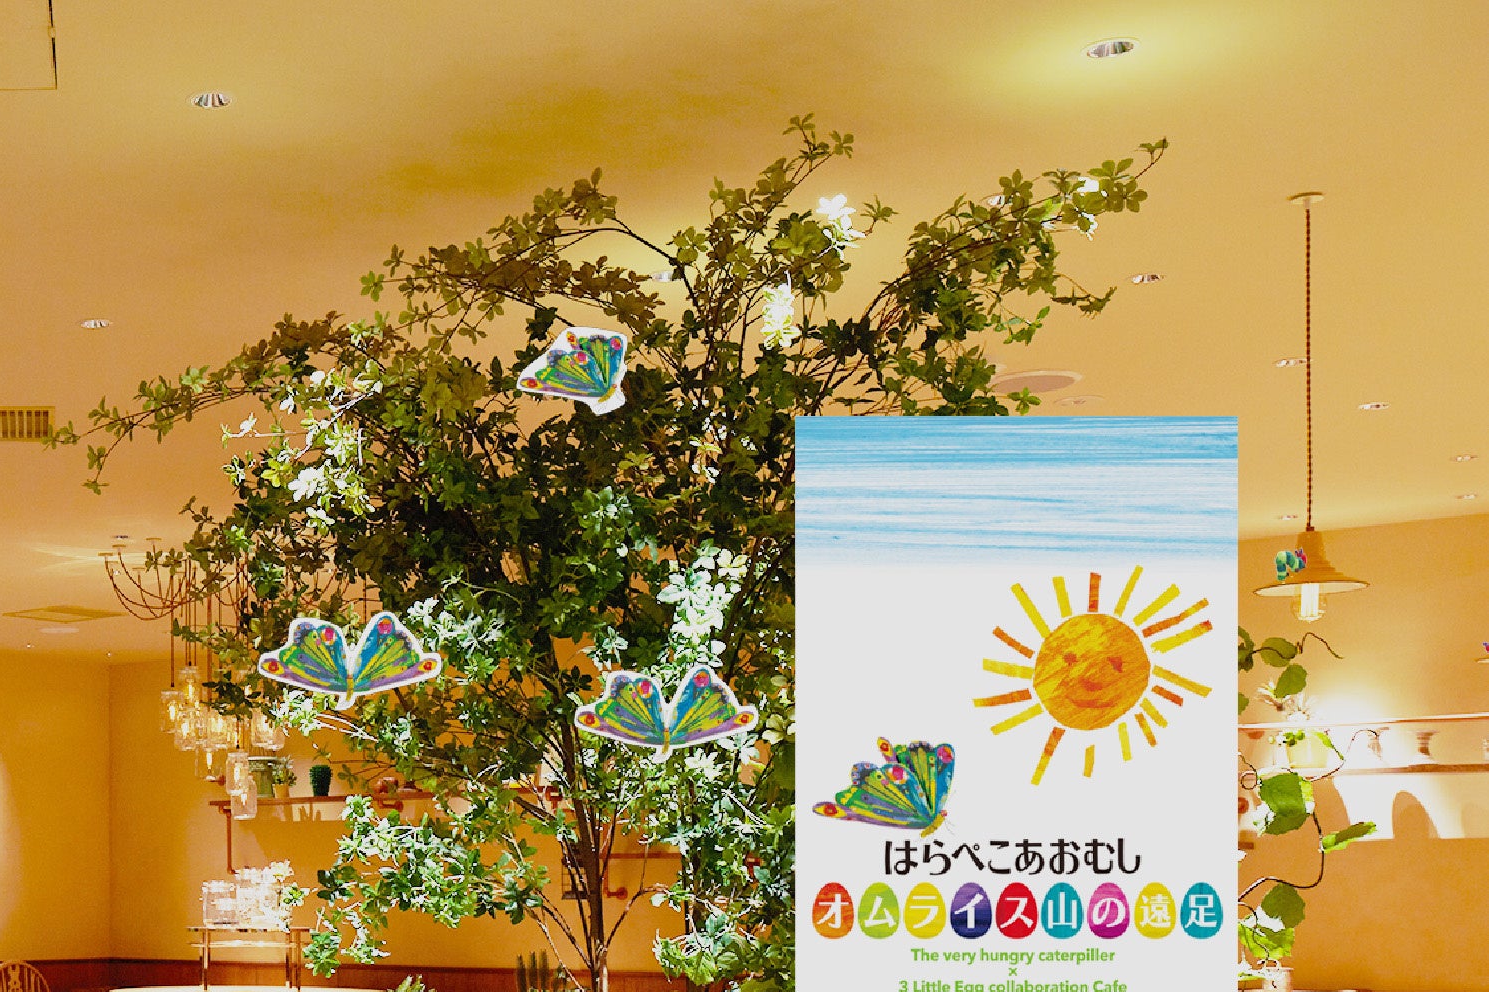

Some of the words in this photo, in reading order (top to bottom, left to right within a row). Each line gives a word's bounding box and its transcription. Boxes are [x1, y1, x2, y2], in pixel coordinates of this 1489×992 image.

[884, 837, 1141, 876] はらぺこあおむし
[814, 889, 1226, 932] オムライス山の遠足
[910, 947, 940, 962] The
[942, 950, 977, 966] very
[979, 947, 1035, 966] hungry
[1038, 947, 1116, 966] caterpiller
